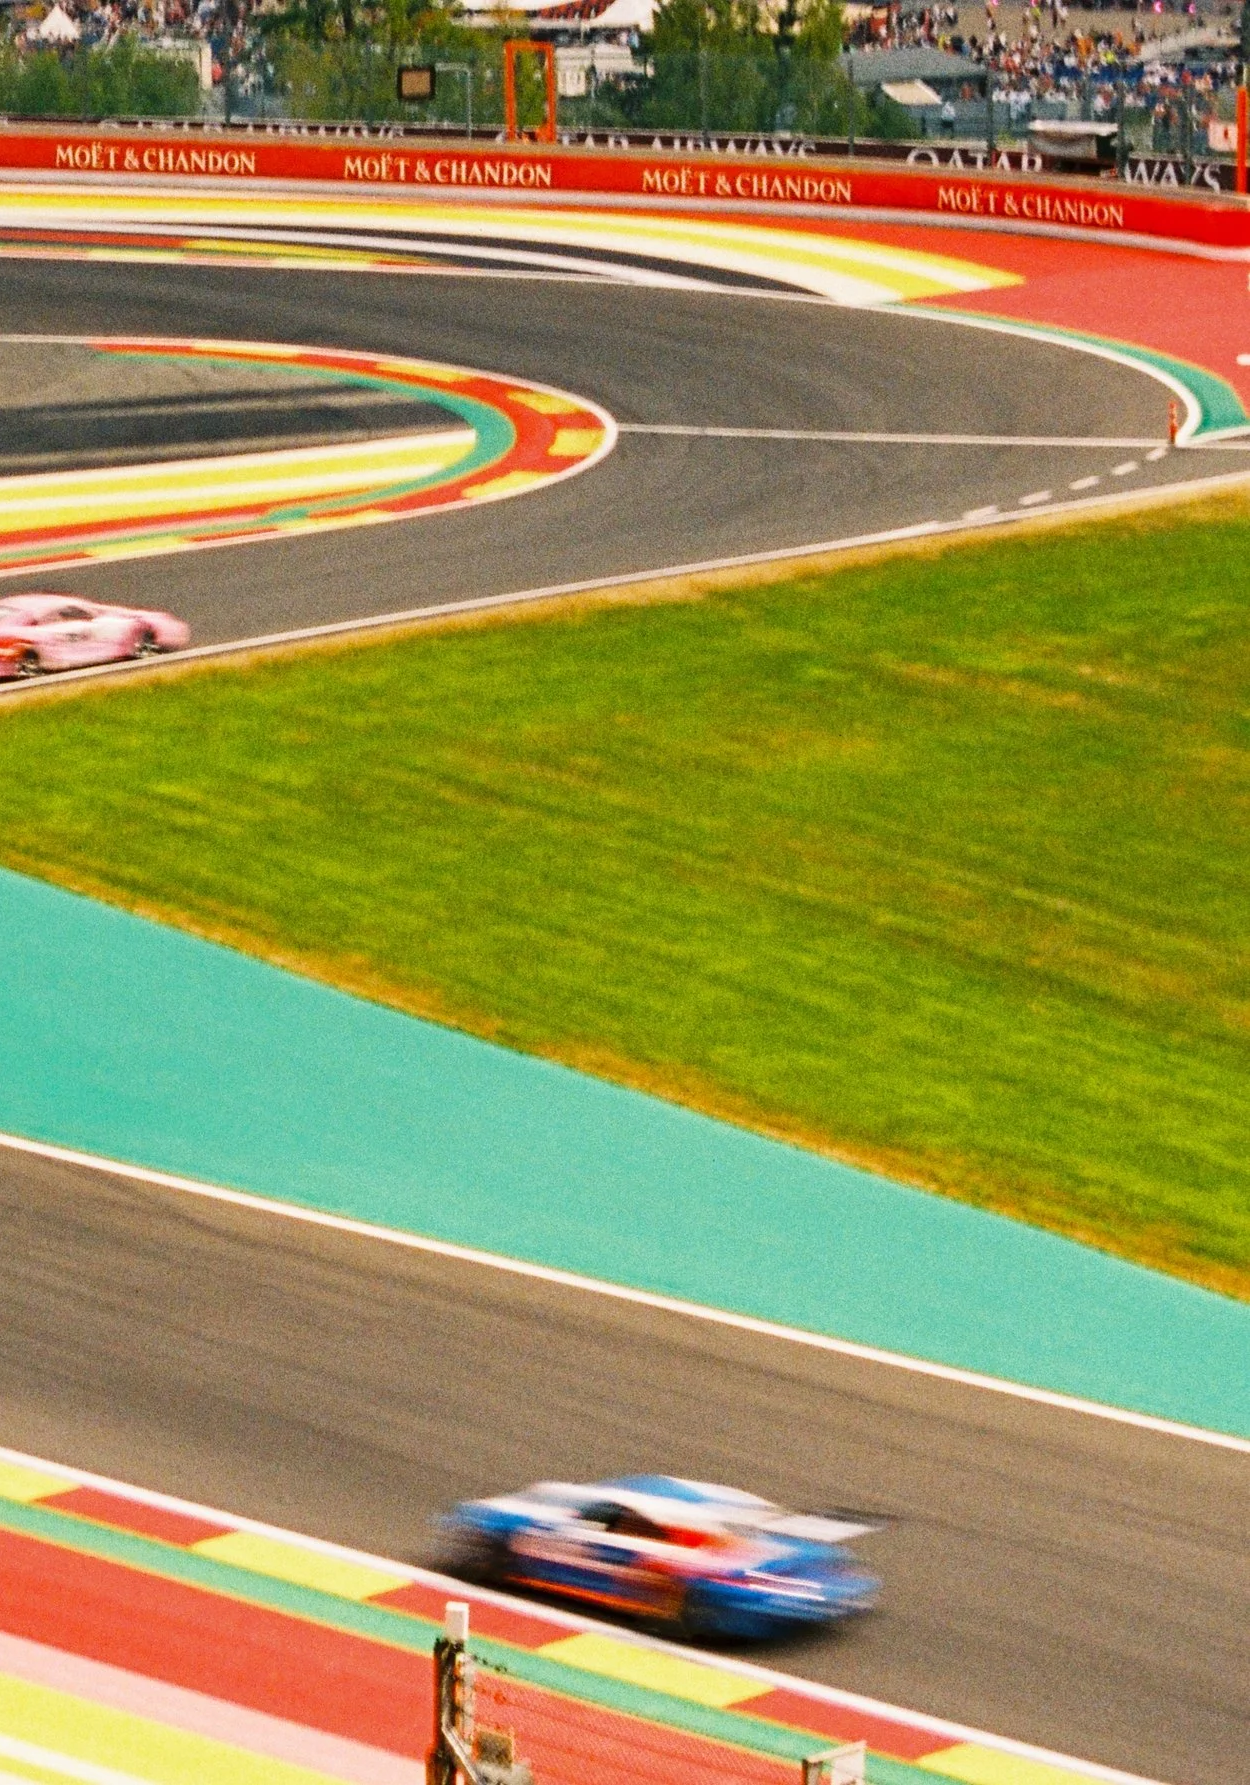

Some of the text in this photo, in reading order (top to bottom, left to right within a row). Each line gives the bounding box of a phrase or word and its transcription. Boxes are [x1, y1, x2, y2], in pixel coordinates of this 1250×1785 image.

[58, 141, 255, 175] MOËT & CHANDON
[346, 153, 552, 187] MOËT & CHANDON
[642, 167, 851, 202] MOËT & CHANDON
[938, 185, 1123, 227] MOËT & CHANDON
